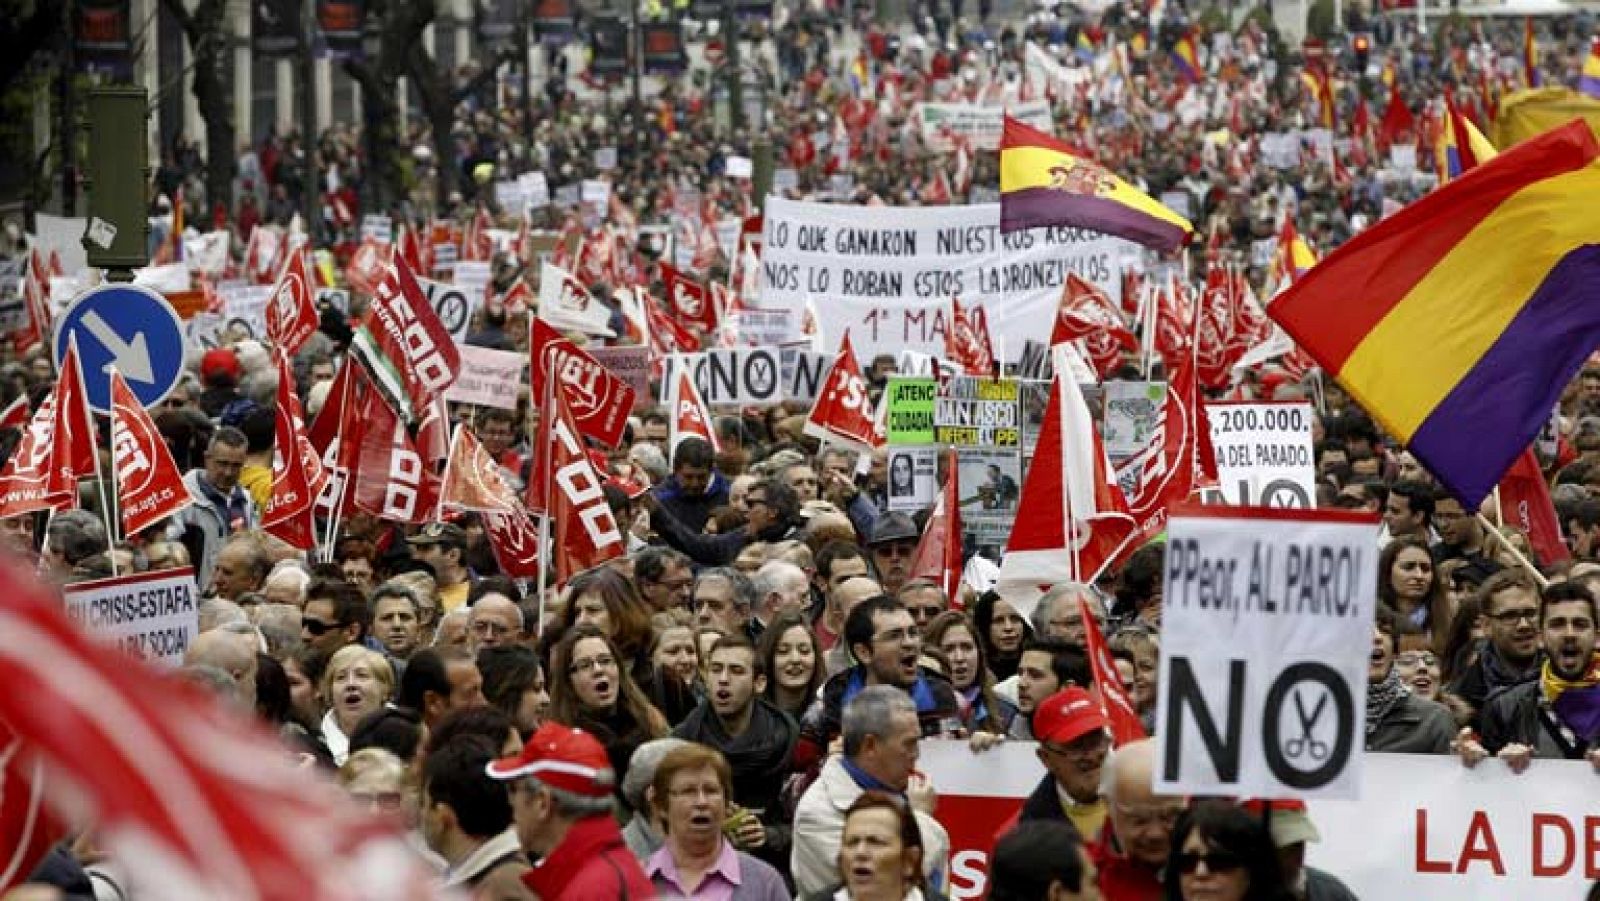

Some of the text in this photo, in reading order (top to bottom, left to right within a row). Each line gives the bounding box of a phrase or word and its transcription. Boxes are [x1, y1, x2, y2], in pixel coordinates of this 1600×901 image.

[767, 218, 789, 248] LO
[797, 224, 828, 253] QUE
[835, 228, 917, 257] GANARON
[765, 261, 799, 291] NOS
[807, 266, 830, 293] LO
[842, 268, 903, 297] ROBAN
[913, 268, 964, 298] ESTOS
[709, 350, 777, 400] NO
[1228, 444, 1252, 467] DEL
[1167, 538, 1362, 624] PPeor, AL PARO!
[1163, 656, 1356, 792] NO
[1416, 808, 1507, 877] LA
